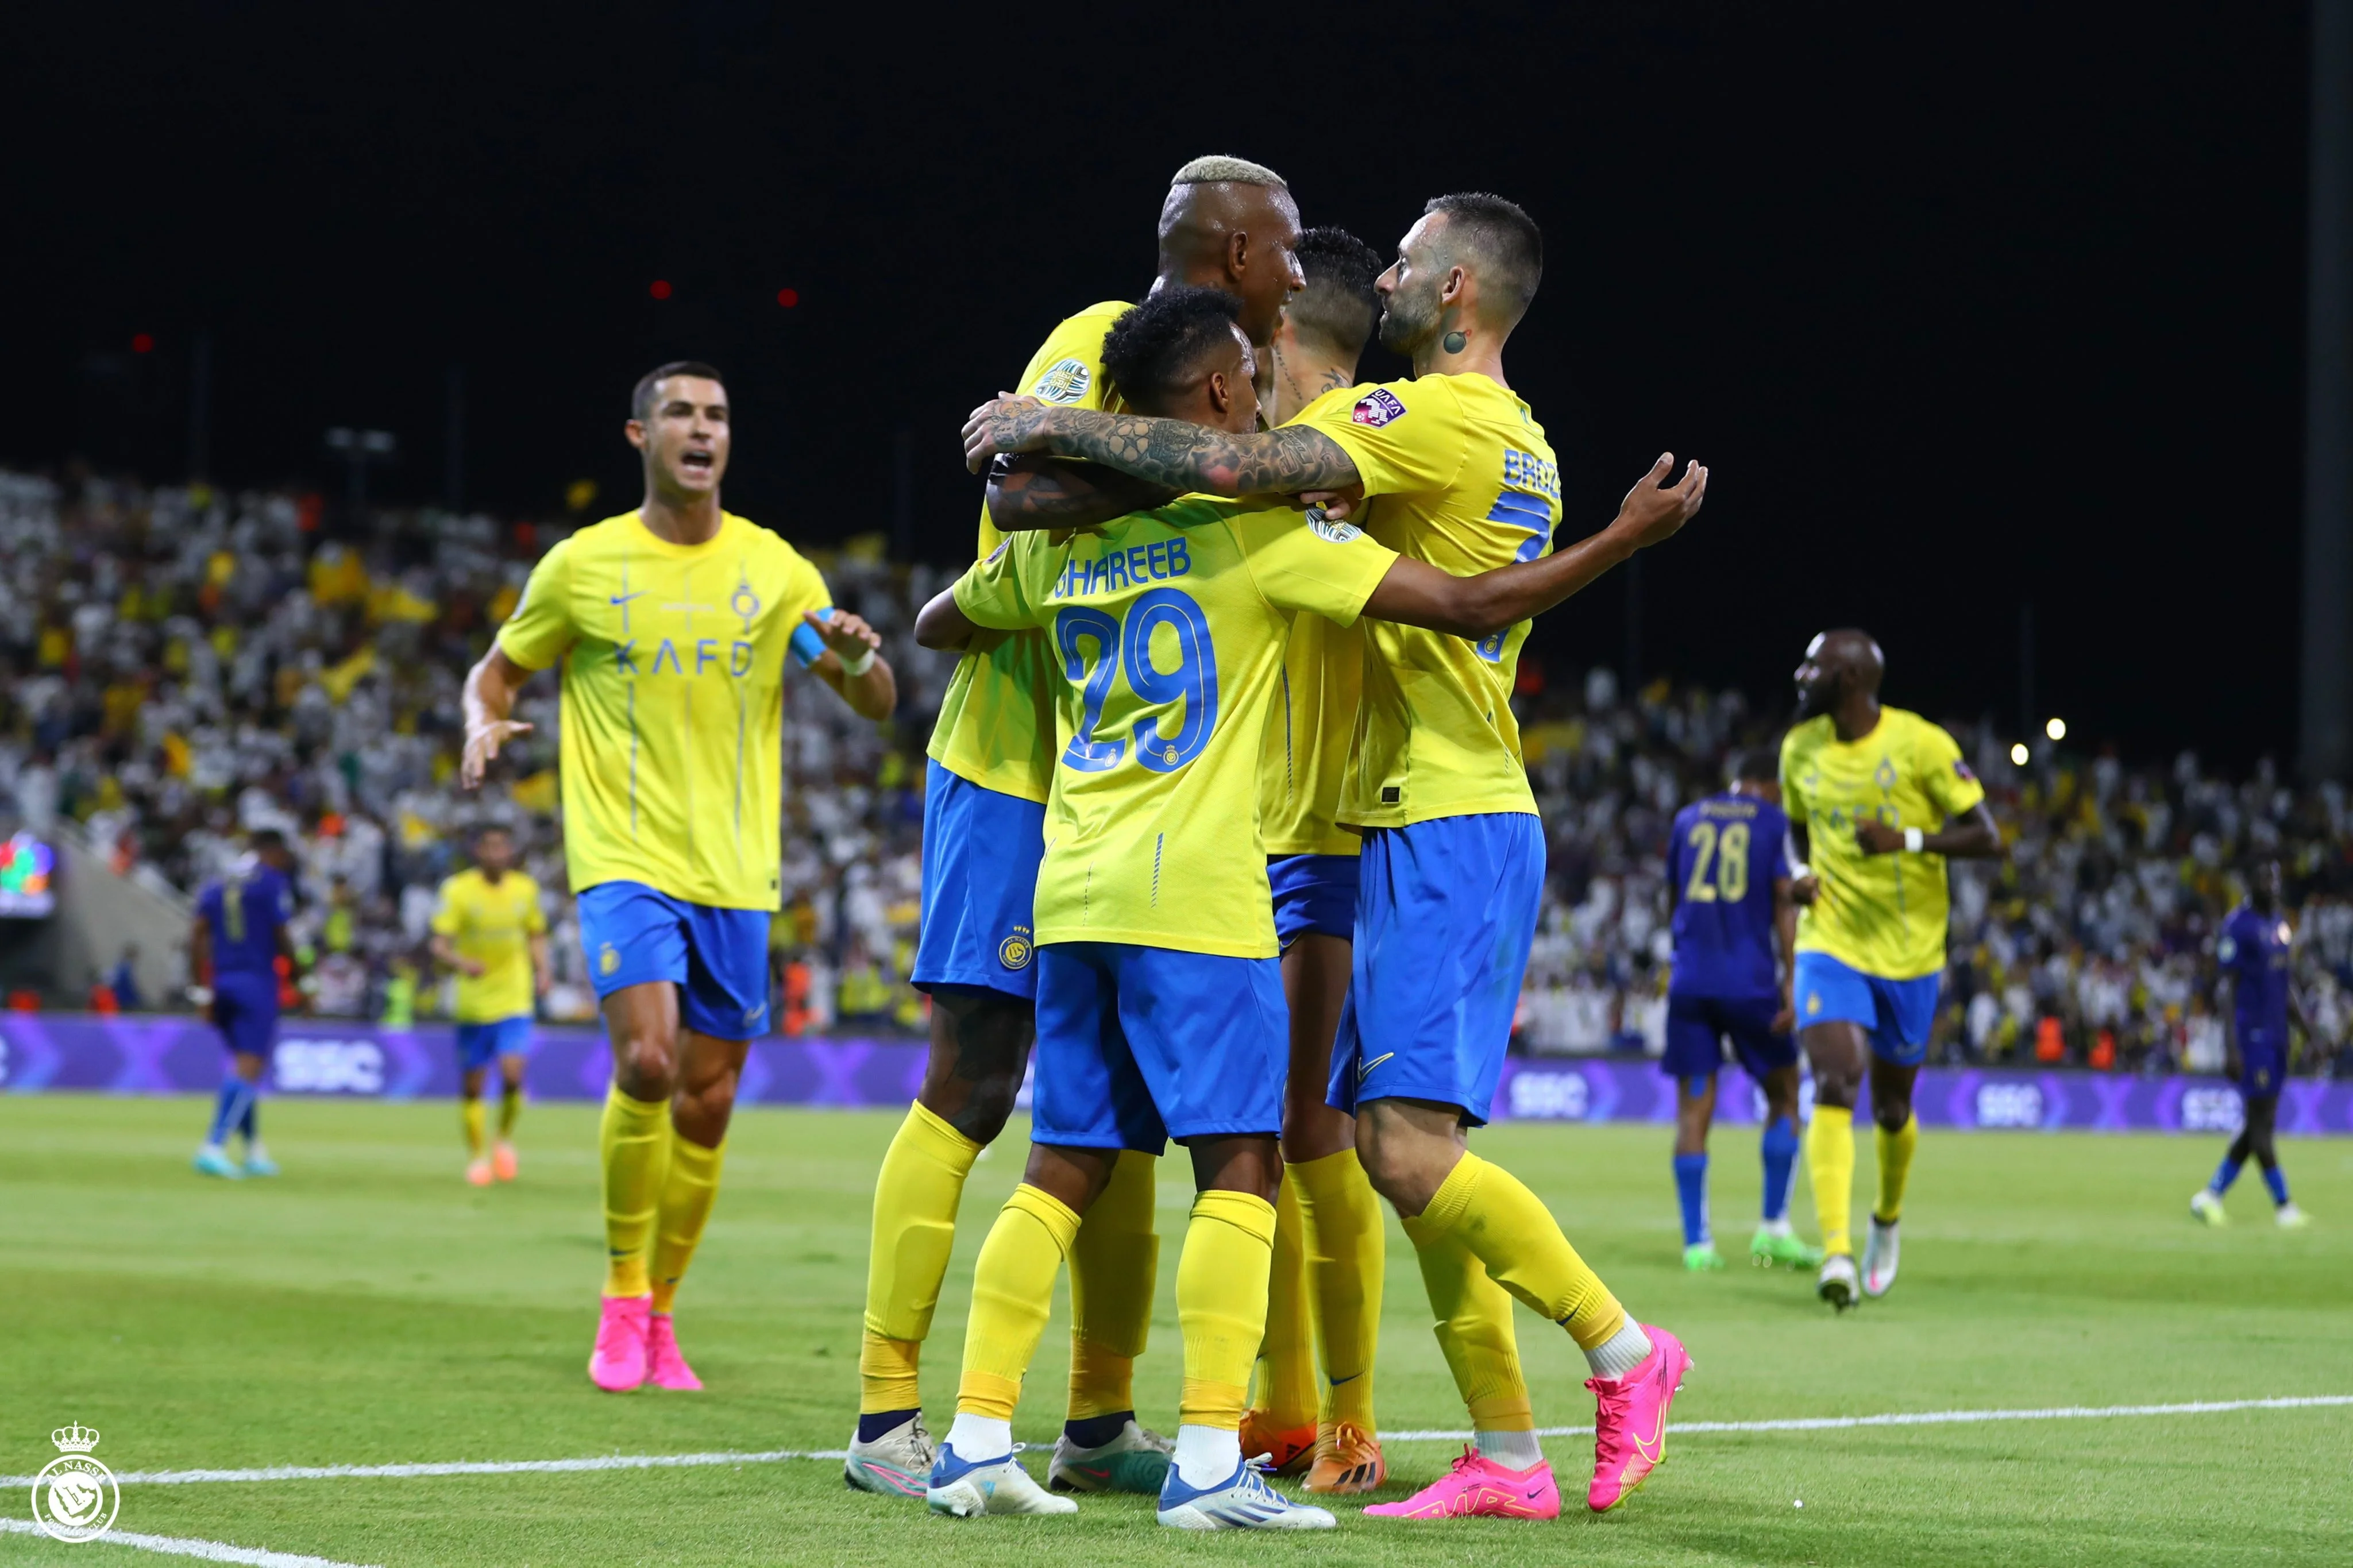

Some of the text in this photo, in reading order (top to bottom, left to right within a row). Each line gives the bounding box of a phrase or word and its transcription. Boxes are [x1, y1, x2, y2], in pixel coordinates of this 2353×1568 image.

[1375, 390, 1401, 415] UAFA
[1504, 449, 1561, 499] BROZ
[612, 637, 754, 678] KAFD
[1056, 588, 1218, 773] 29
[1685, 821, 1751, 903] 28
